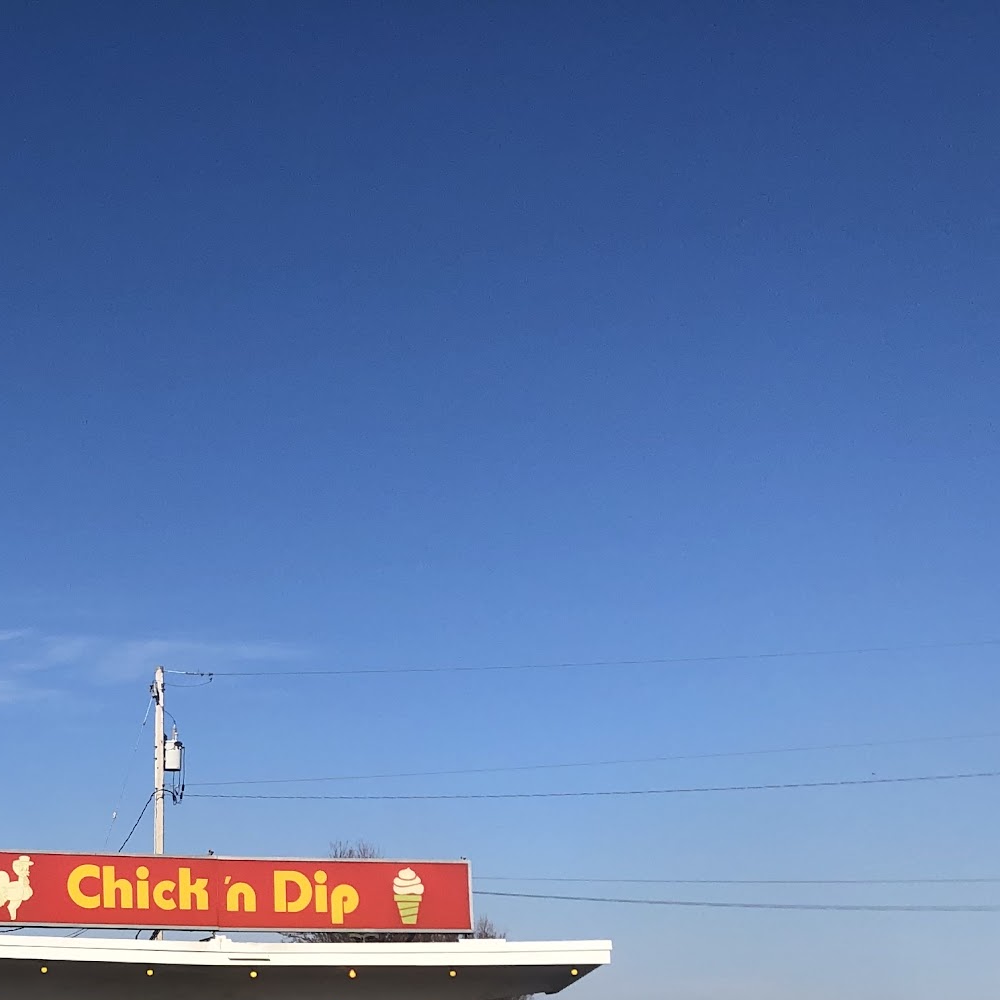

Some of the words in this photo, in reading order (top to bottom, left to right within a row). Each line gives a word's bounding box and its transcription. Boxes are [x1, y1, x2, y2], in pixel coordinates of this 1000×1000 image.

[67, 864, 208, 910] Chick
[224, 876, 257, 912] 'n
[274, 870, 359, 924] Dip
